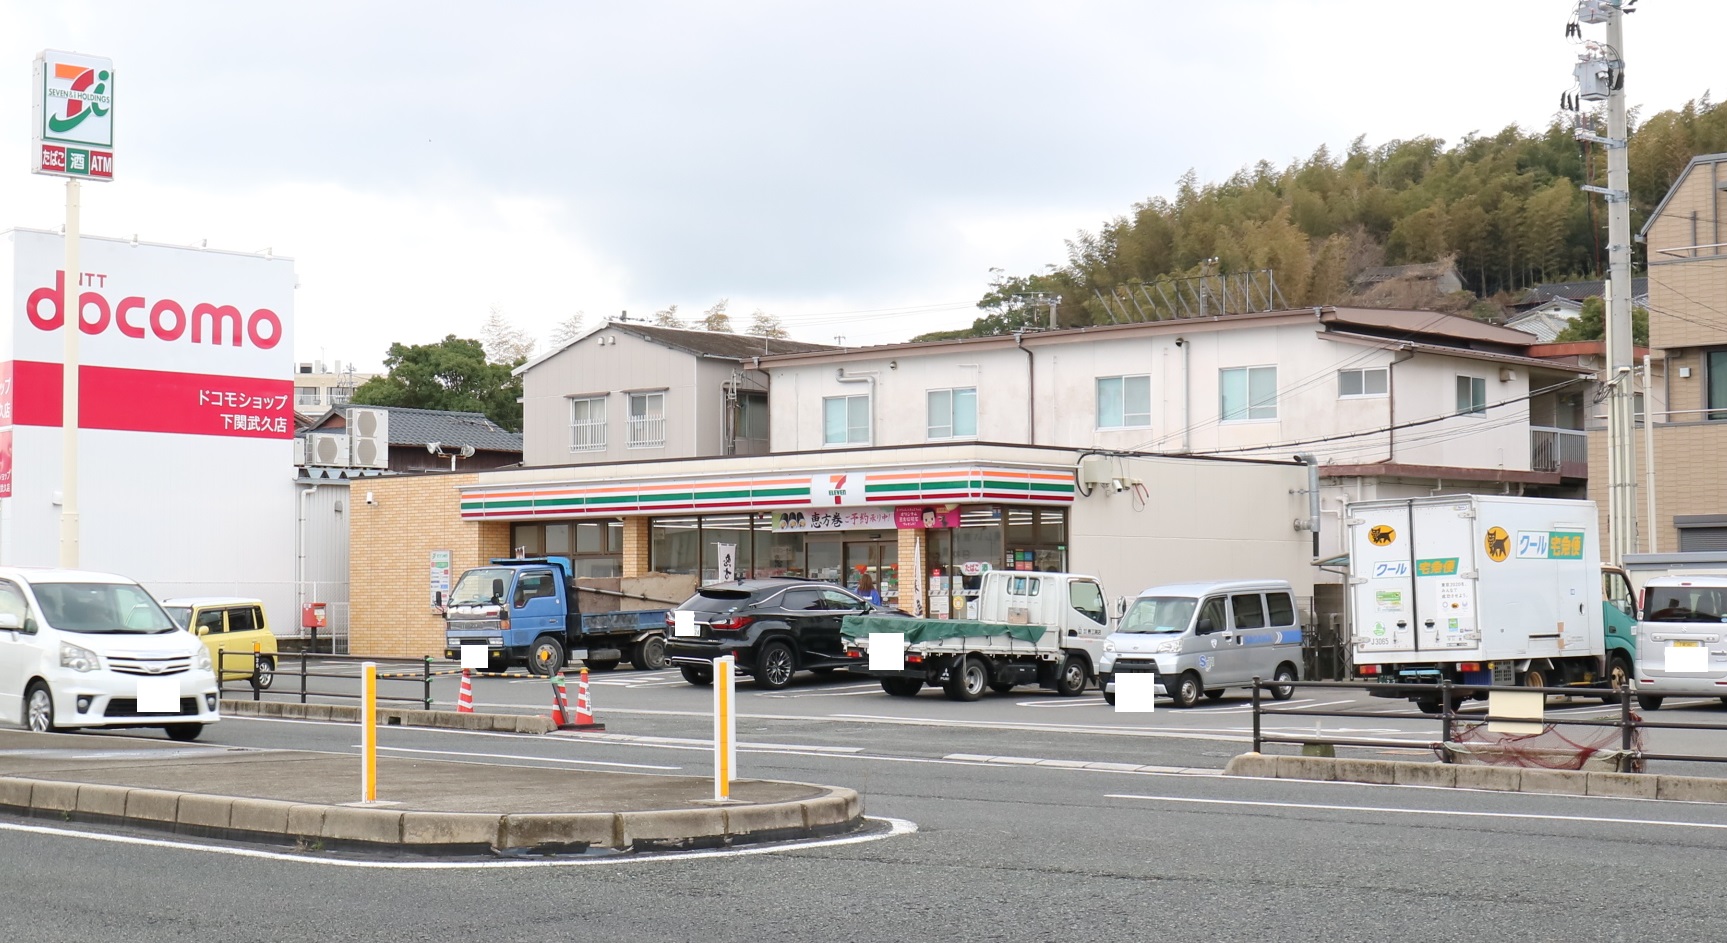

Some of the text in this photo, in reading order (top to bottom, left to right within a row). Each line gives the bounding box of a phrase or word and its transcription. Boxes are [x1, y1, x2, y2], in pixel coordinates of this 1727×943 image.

[78, 93, 110, 104] HOLDINGS
[42, 149, 65, 167] たばこ
[70, 152, 85, 170] 酒
[91, 155, 112, 173] ATM
[26, 270, 282, 350] docomo
[199, 389, 288, 410] ドコモショップ
[220, 413, 288, 433] 下関武久店
[811, 512, 842, 528] 恵方巻
[1519, 535, 1582, 556] クール 宅急便
[965, 563, 980, 572] たばこ
[1376, 559, 1456, 577] クール 宅急便
[1371, 638, 1389, 646] J3065
